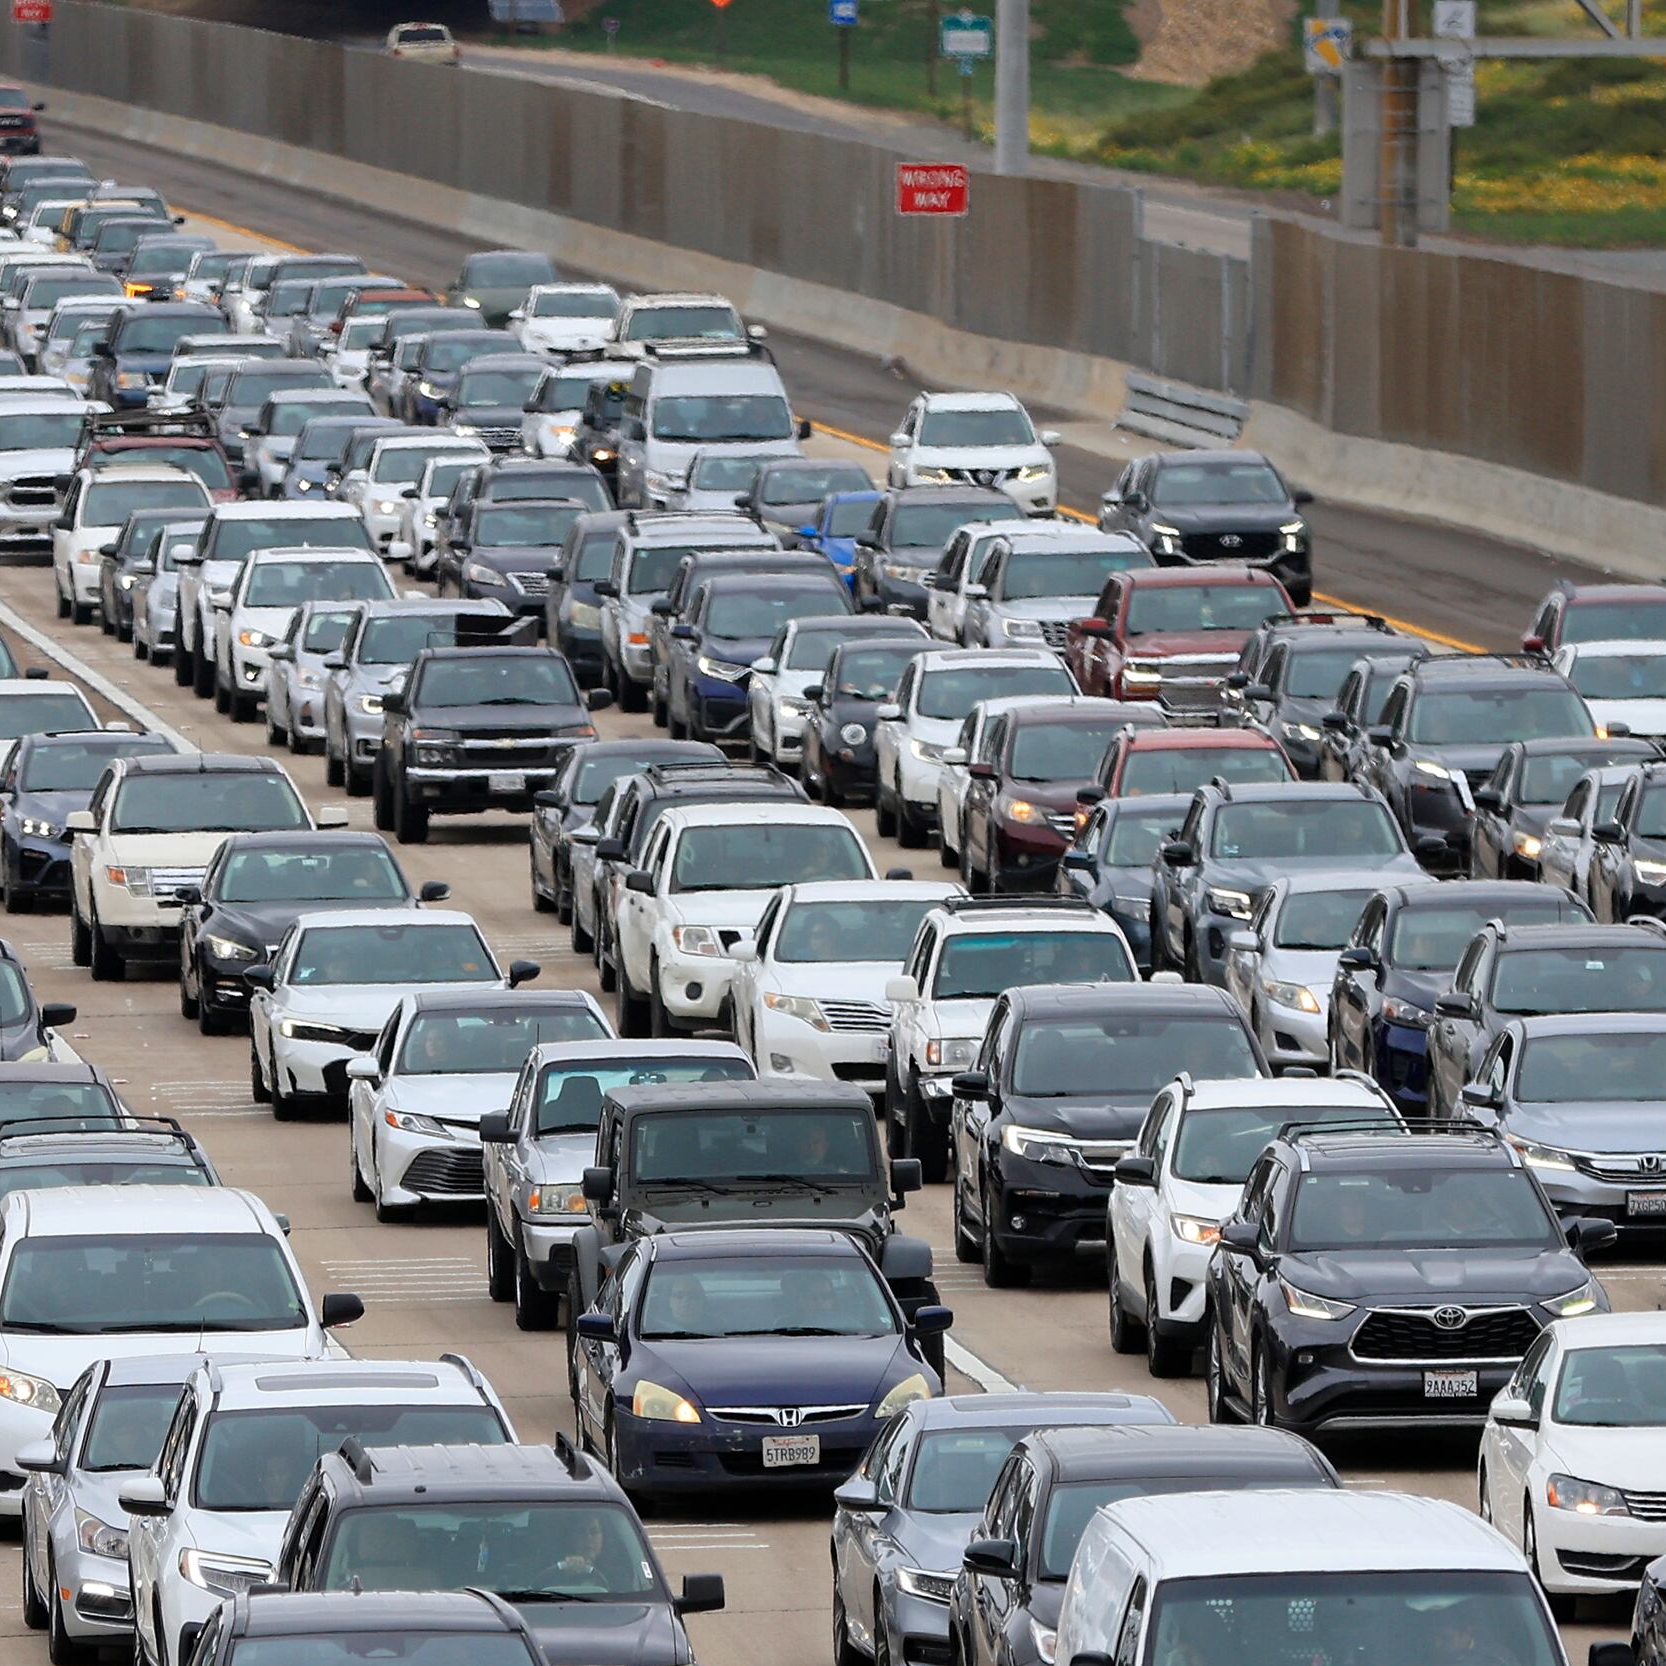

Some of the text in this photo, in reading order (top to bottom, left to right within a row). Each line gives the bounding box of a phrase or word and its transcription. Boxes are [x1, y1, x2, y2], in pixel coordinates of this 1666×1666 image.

[901, 169, 966, 189] WRONG
[914, 191, 951, 208] WAY
[1426, 1379, 1475, 1394] 9AAA352
[766, 1446, 816, 1462] 5TRB989
